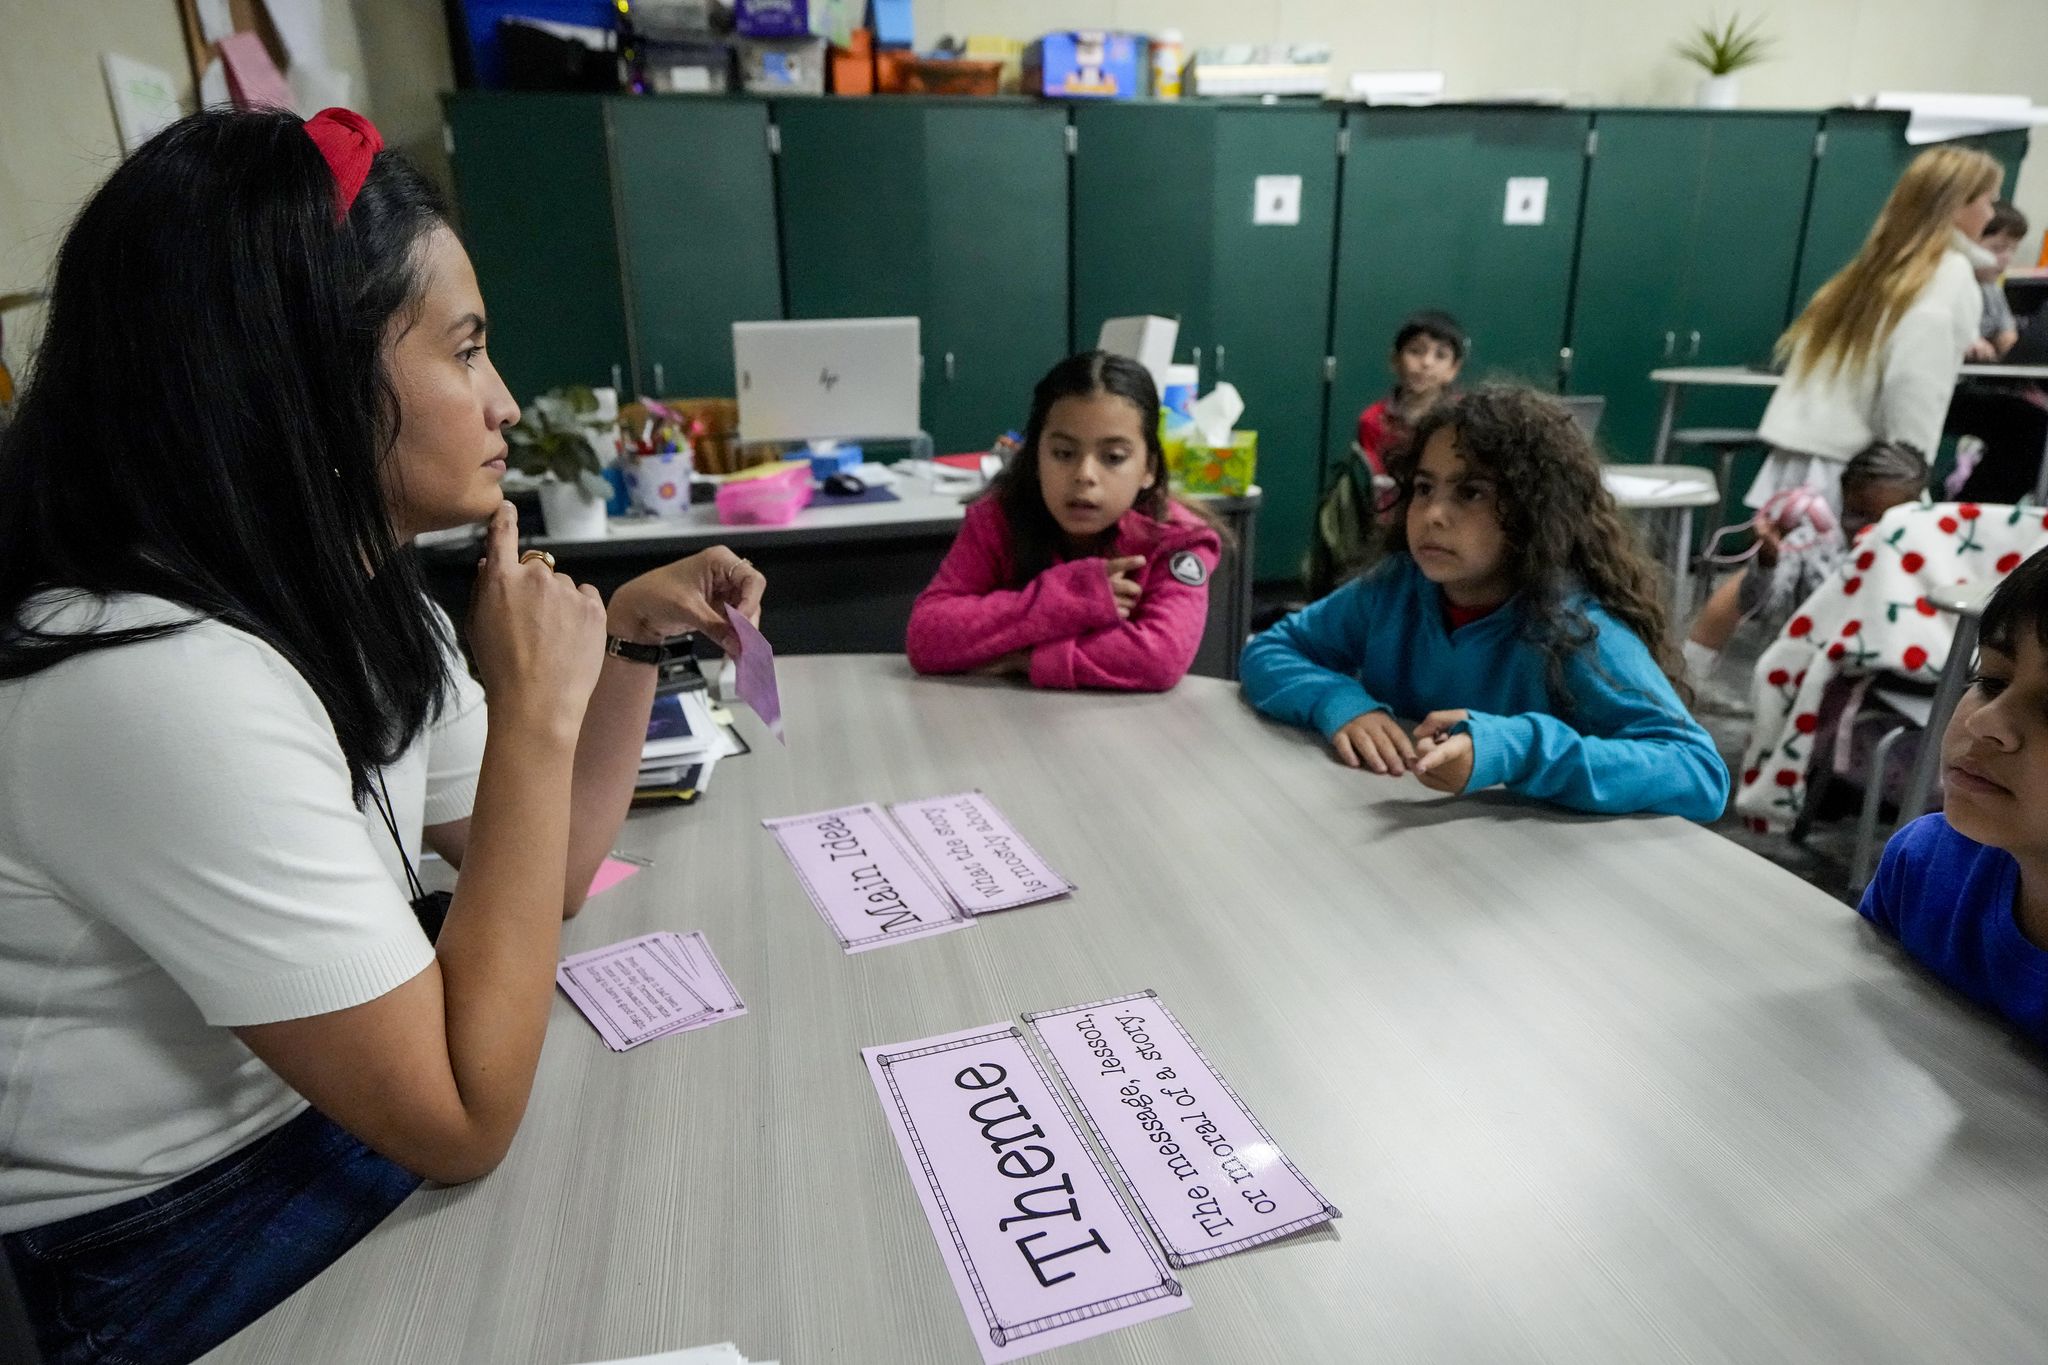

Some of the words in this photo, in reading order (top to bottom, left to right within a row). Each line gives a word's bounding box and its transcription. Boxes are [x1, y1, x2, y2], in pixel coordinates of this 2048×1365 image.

[817, 817, 867, 862] Idea
[920, 806, 956, 837] story
[946, 838, 975, 862] the
[983, 835, 1036, 880] mostly
[851, 864, 922, 933] Main
[963, 863, 1005, 898] What
[1022, 880, 1048, 893] is
[1073, 1013, 1127, 1077] lesson,
[1115, 1009, 1164, 1062] story.
[1156, 1065, 1177, 1081] a
[1160, 1087, 1197, 1107] of
[1119, 1079, 1200, 1182] message,
[1180, 1111, 1255, 1186] moral
[955, 1063, 1111, 1288] Theme
[1187, 1183, 1234, 1238] The
[1240, 1188, 1276, 1214] or
